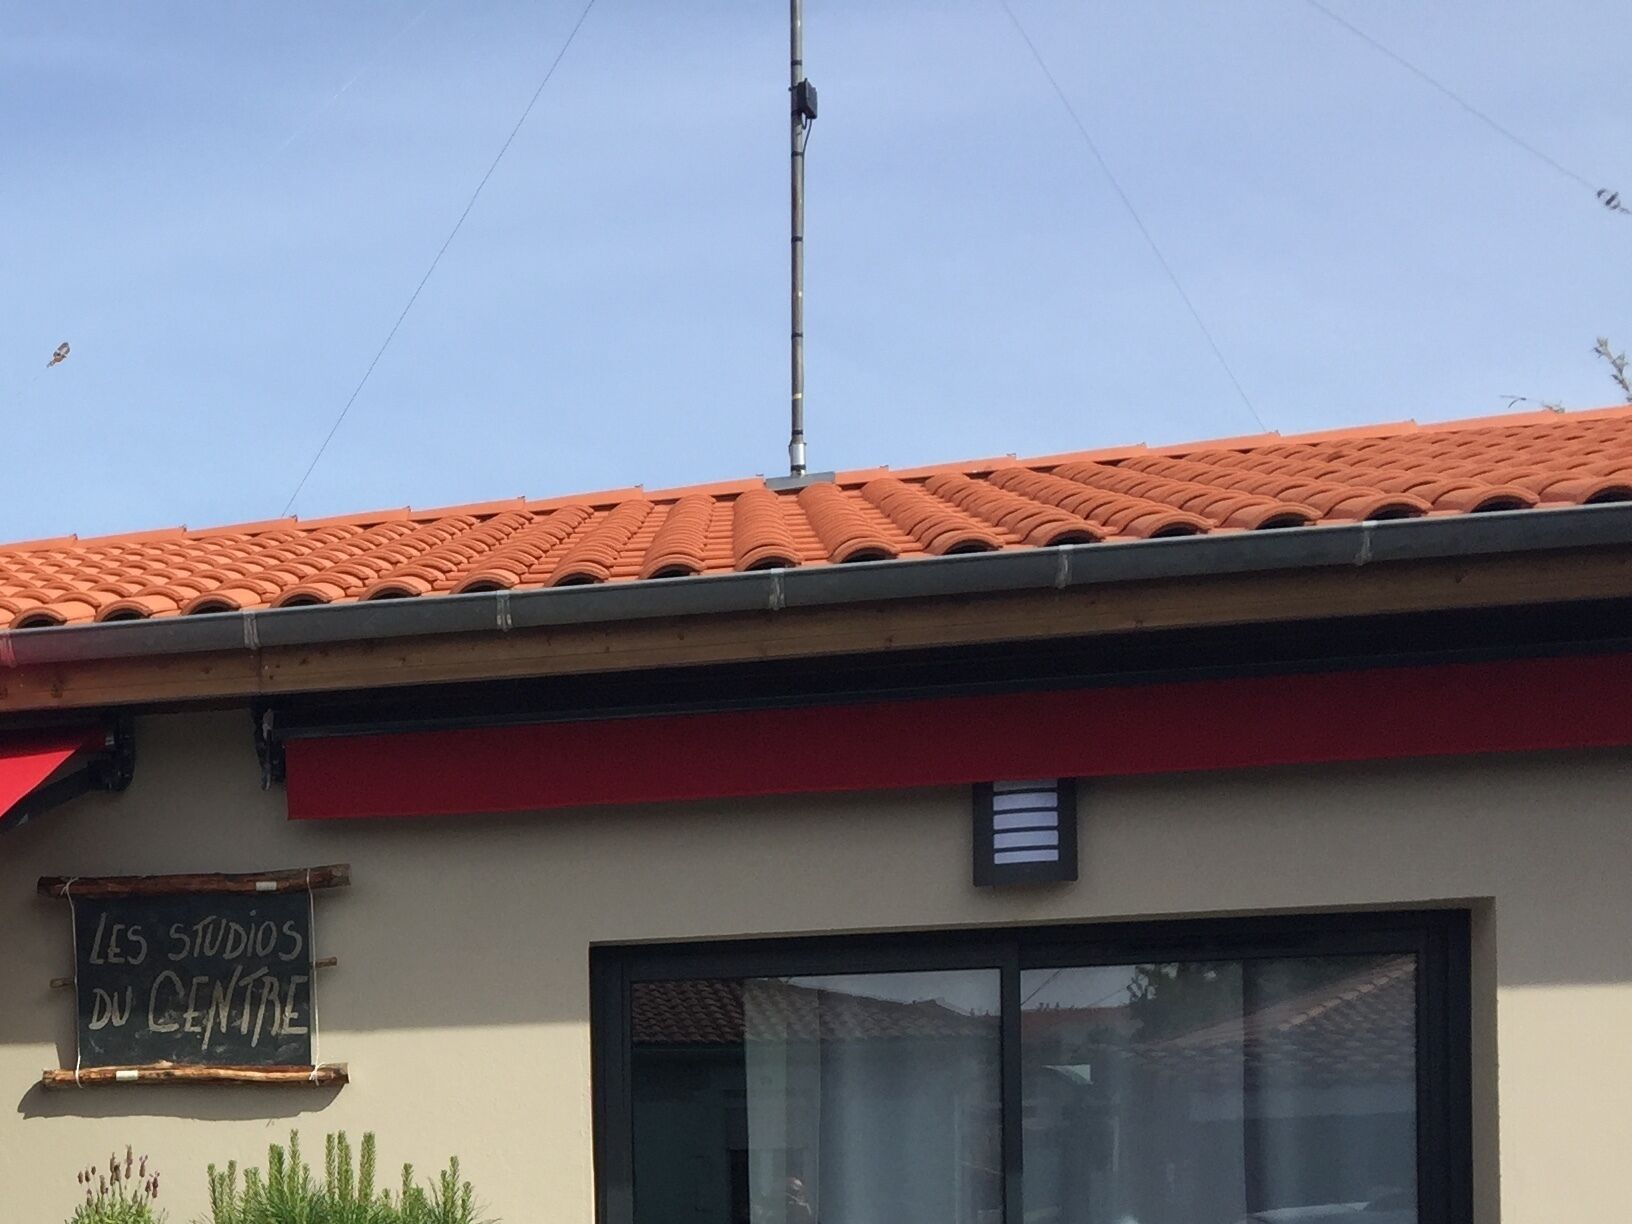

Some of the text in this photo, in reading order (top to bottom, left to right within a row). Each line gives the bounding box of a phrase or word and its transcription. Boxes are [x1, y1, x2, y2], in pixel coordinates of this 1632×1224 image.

[88, 912, 148, 966] LES
[88, 964, 309, 1052] DU CENTRE
